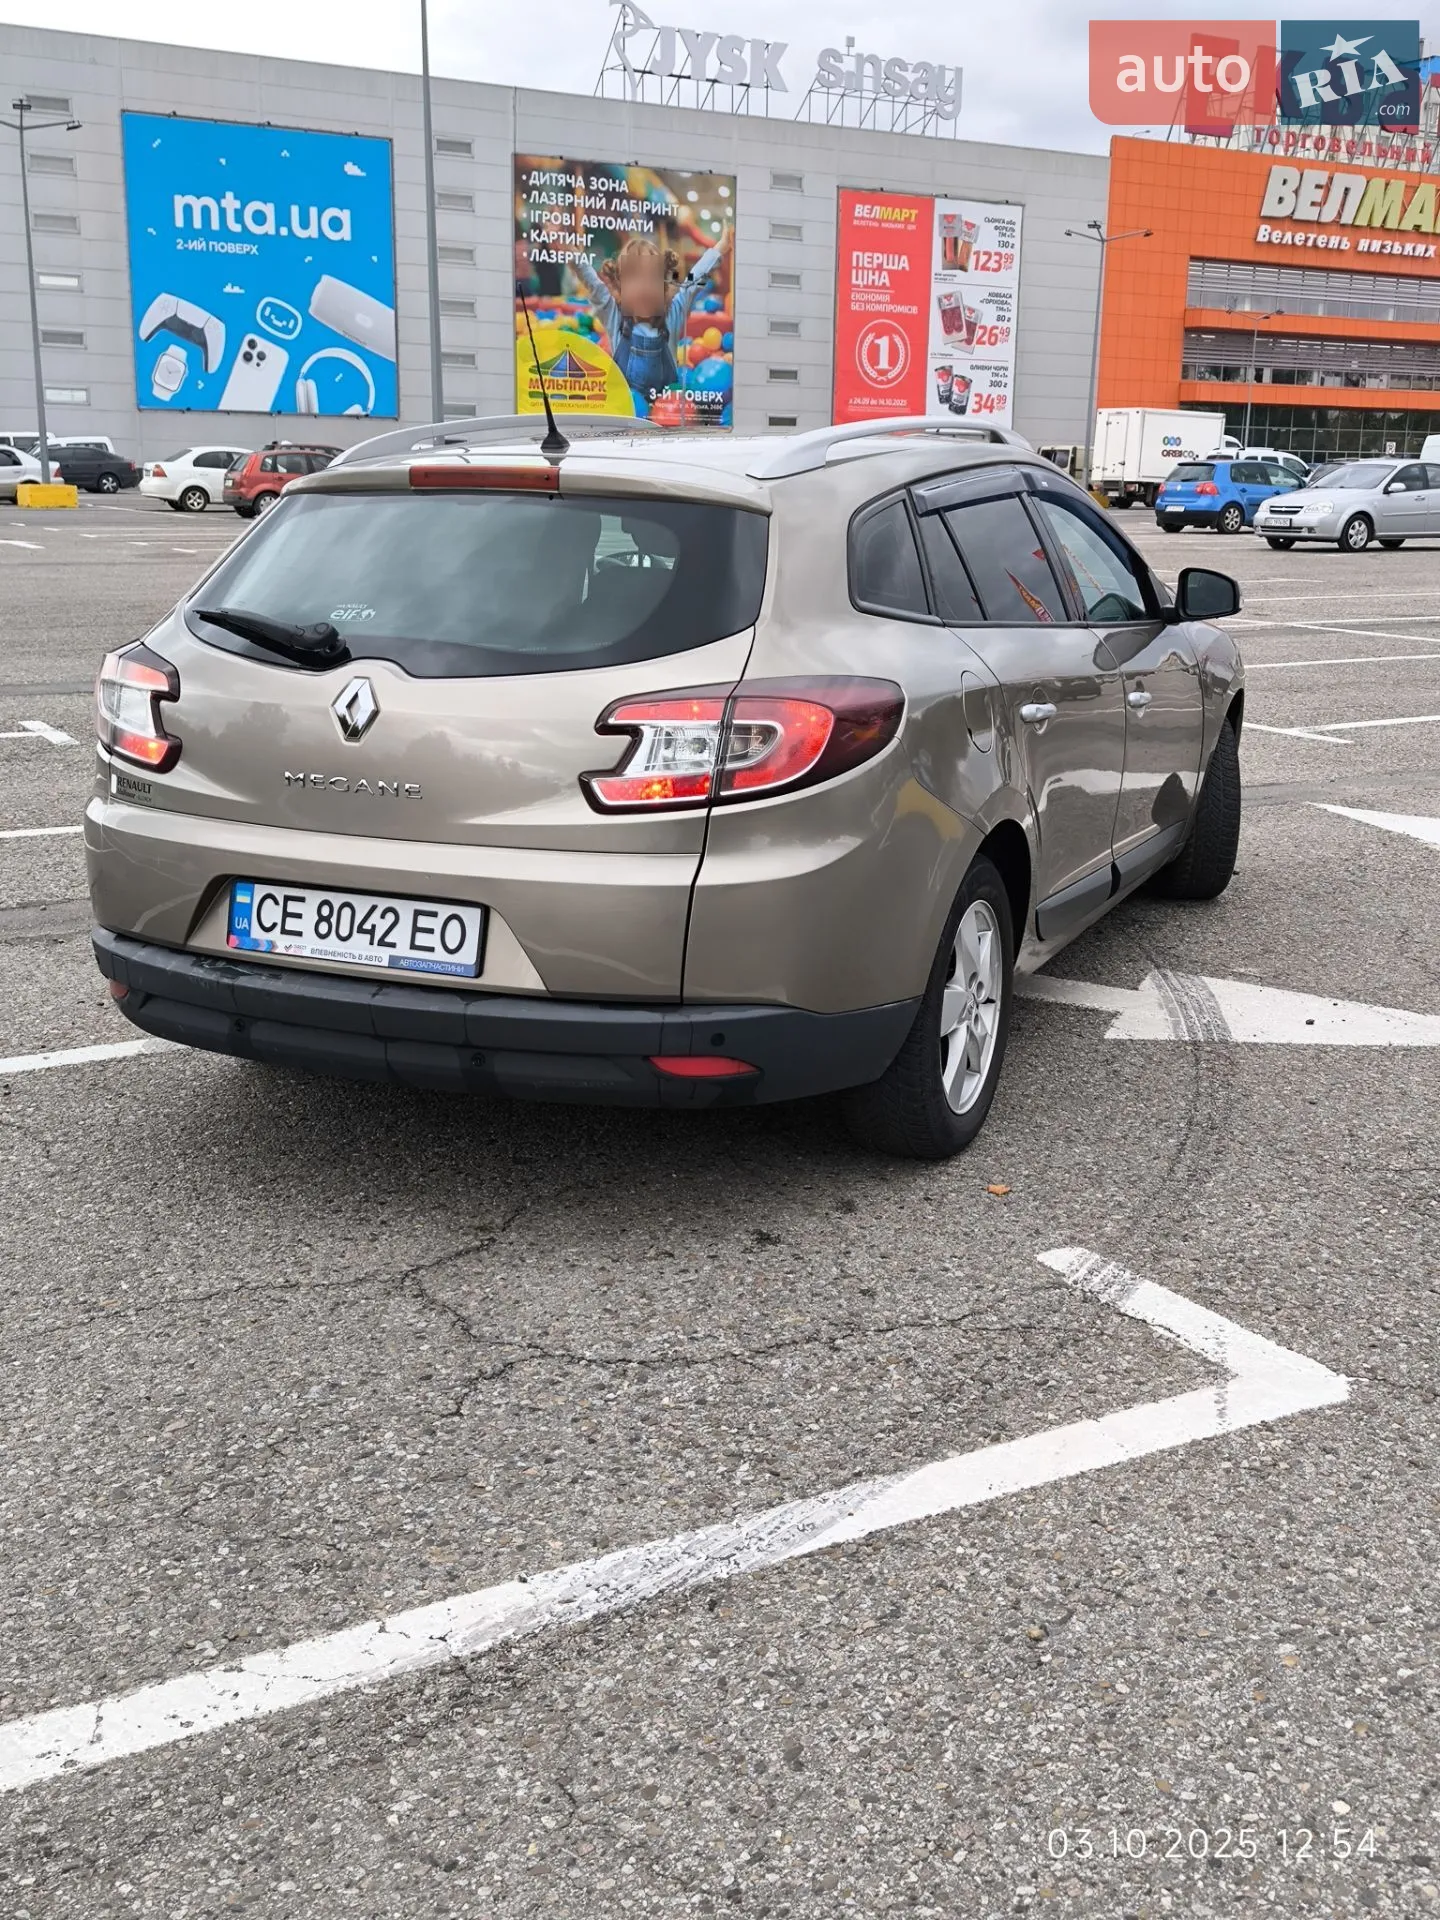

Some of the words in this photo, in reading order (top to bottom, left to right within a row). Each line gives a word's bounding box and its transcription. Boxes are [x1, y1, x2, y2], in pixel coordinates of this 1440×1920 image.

[650, 25, 789, 93] JYSK
[816, 36, 963, 121] sinsay
[529, 171, 585, 189] ДИТЯЧА
[589, 177, 629, 194] ЗОНА
[529, 191, 606, 210] ЛАЗЕРНИЙ
[610, 198, 680, 217] ЛАБІРИНТ
[1260, 164, 1440, 234] ВЕЛМА
[173, 191, 352, 241] mta.ua
[531, 210, 575, 227] ІГРОВІ
[580, 216, 654, 233] АВТОМАТИ
[854, 203, 918, 222] ВЕЛМАРТ
[176, 238, 207, 252] 2-ИЙ
[208, 242, 259, 256] ПОВЕРХ
[530, 230, 594, 247] КАРТИНГ
[997, 240, 1010, 249] 130
[1255, 224, 1351, 251] Велетень
[1357, 238, 1436, 259] низьких
[530, 249, 596, 265] ЛАЗЕРТАГ
[851, 251, 909, 271] ПЕРША
[851, 269, 890, 288] ЦІНА
[851, 291, 890, 302] ЕКОНОМІЯ
[850, 302, 865, 311] БЕЗ
[873, 335, 893, 370] 1
[649, 385, 671, 400] 3-Й
[675, 390, 723, 403] ПОВЕРХ
[1161, 449, 1194, 458] ORBICO
[117, 775, 152, 794] RENAULT
[283, 770, 424, 800] MEGANE
[234, 917, 250, 931] UA
[256, 892, 307, 938] CE
[313, 898, 400, 949] 8042
[409, 908, 467, 955] EO
[310, 948, 357, 960] ВПЕВНЕНІСТЬ
[364, 954, 383, 963] АВТО
[399, 958, 465, 974] АВТОЗАПЧАСТИНИ
